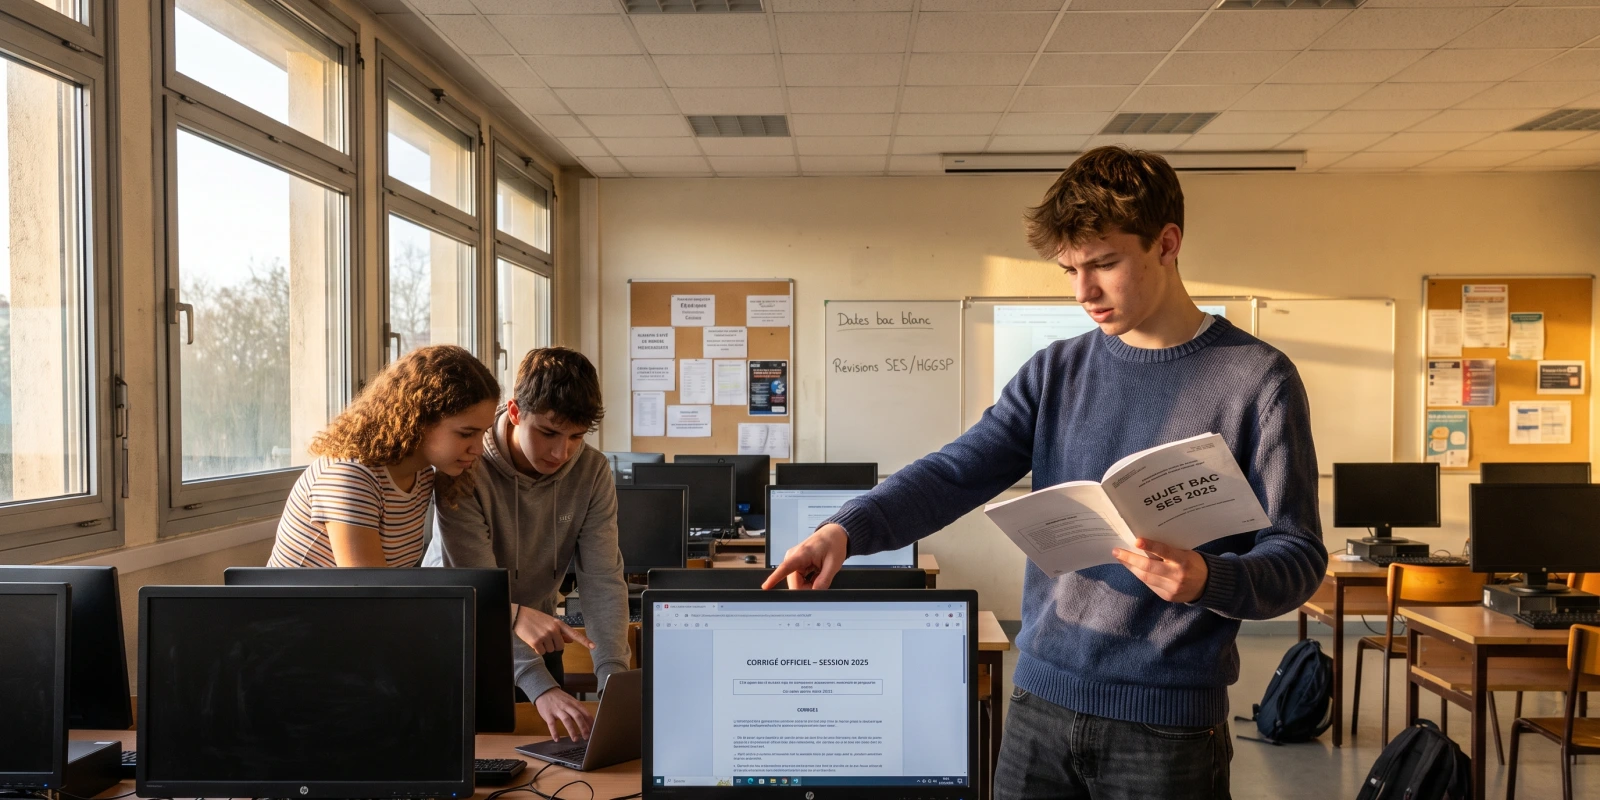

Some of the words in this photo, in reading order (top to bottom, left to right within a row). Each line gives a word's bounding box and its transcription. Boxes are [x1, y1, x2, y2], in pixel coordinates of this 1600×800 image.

[837, 312, 869, 326] Dates
[876, 311, 895, 325] bac
[902, 311, 931, 325] blanc
[832, 357, 879, 373] Révisions
[885, 355, 954, 374] SES/HGGSP
[1143, 482, 1185, 506] SUJET
[1188, 473, 1220, 488] BAC
[1155, 495, 1183, 511] SES
[1186, 484, 1218, 500] 2025
[746, 657, 779, 666] CORRIGÉ
